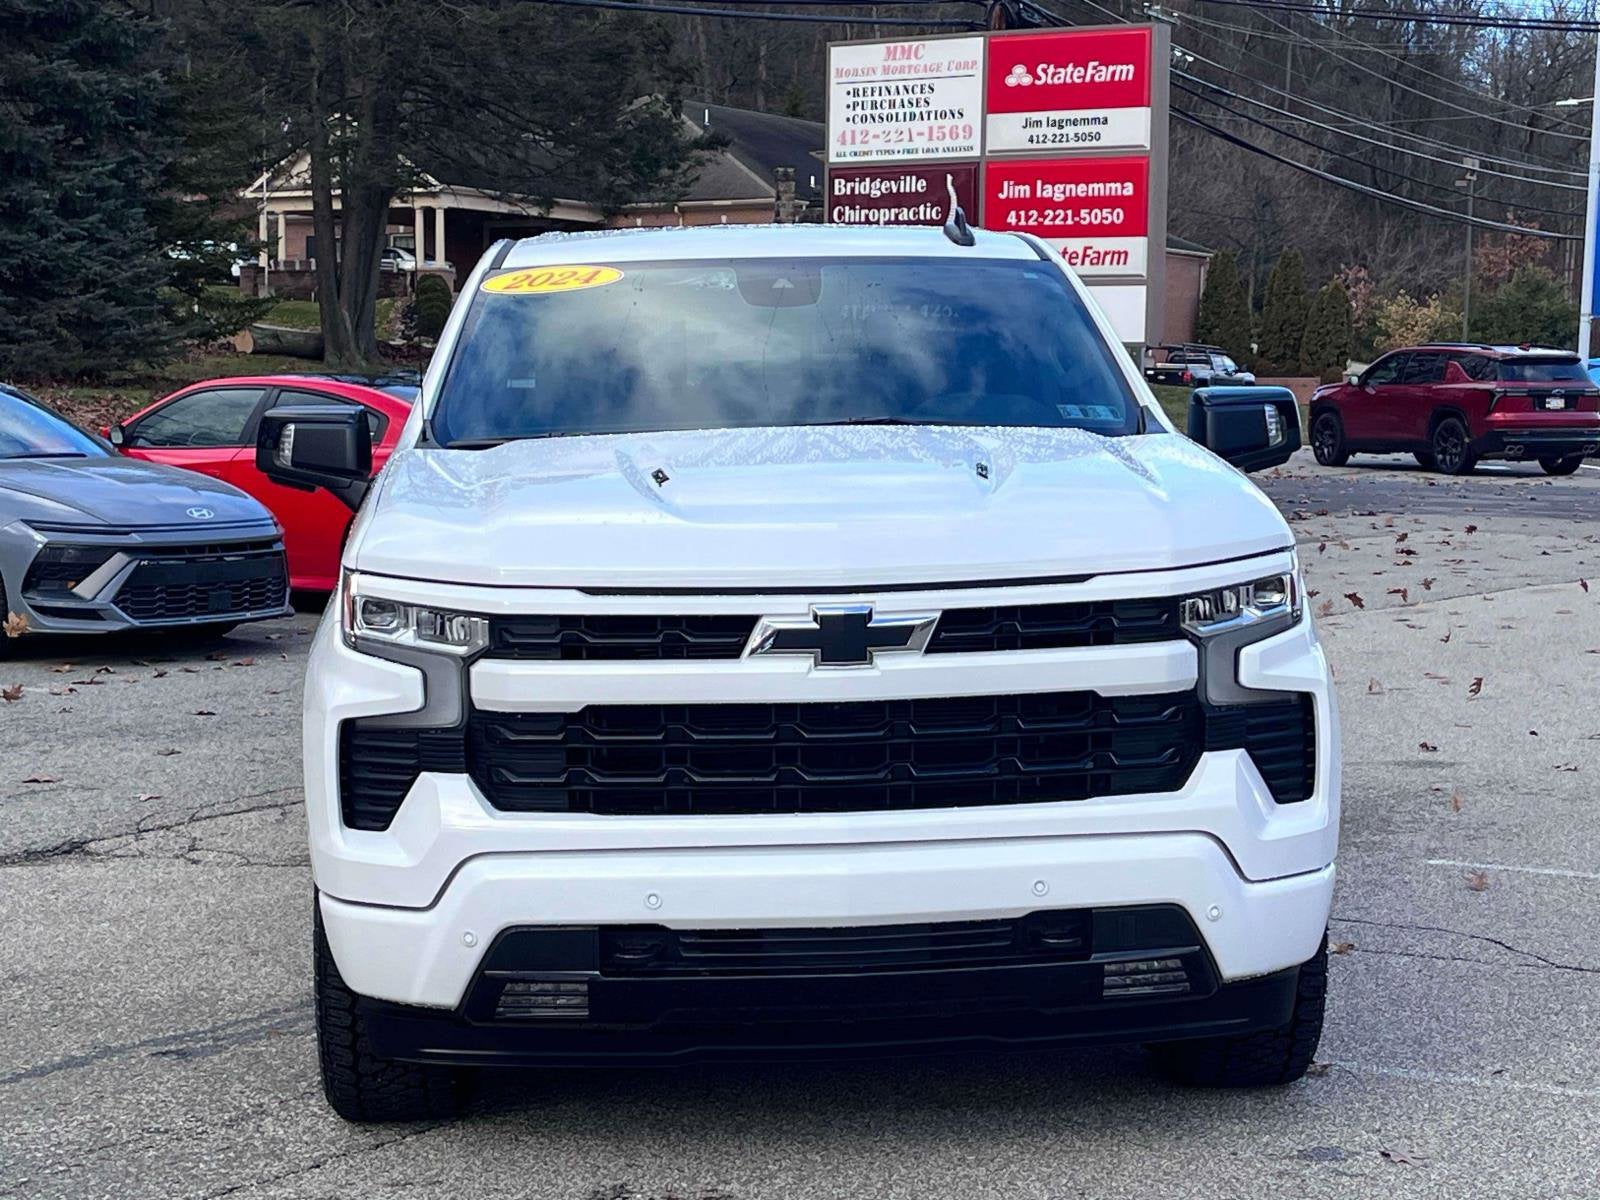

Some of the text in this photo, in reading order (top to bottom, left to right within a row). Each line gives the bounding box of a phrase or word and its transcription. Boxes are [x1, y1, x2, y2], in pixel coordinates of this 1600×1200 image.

[883, 43, 926, 62] MMC
[881, 63, 943, 76] MORTGAGE
[852, 83, 935, 98] REFINANCES
[851, 97, 931, 111] PURCHASES
[851, 108, 965, 125] CONSOLIDATIONS
[1021, 116, 1043, 130] Jim
[836, 124, 974, 146] 412-221-1569
[1027, 131, 1102, 145] 412-221-5050
[849, 150, 873, 158] CREDIT
[875, 149, 896, 157] TYPES
[902, 147, 919, 155] FREE
[921, 146, 940, 154] LOAN
[942, 145, 974, 154] ANALYSIS
[833, 175, 927, 198] Bridgeville
[998, 181, 1031, 200] Jim
[832, 202, 942, 225] Chiropractic
[1006, 208, 1124, 226] 412-221-5050
[1060, 246, 1129, 267] teFarm
[502, 269, 603, 290] 2024
